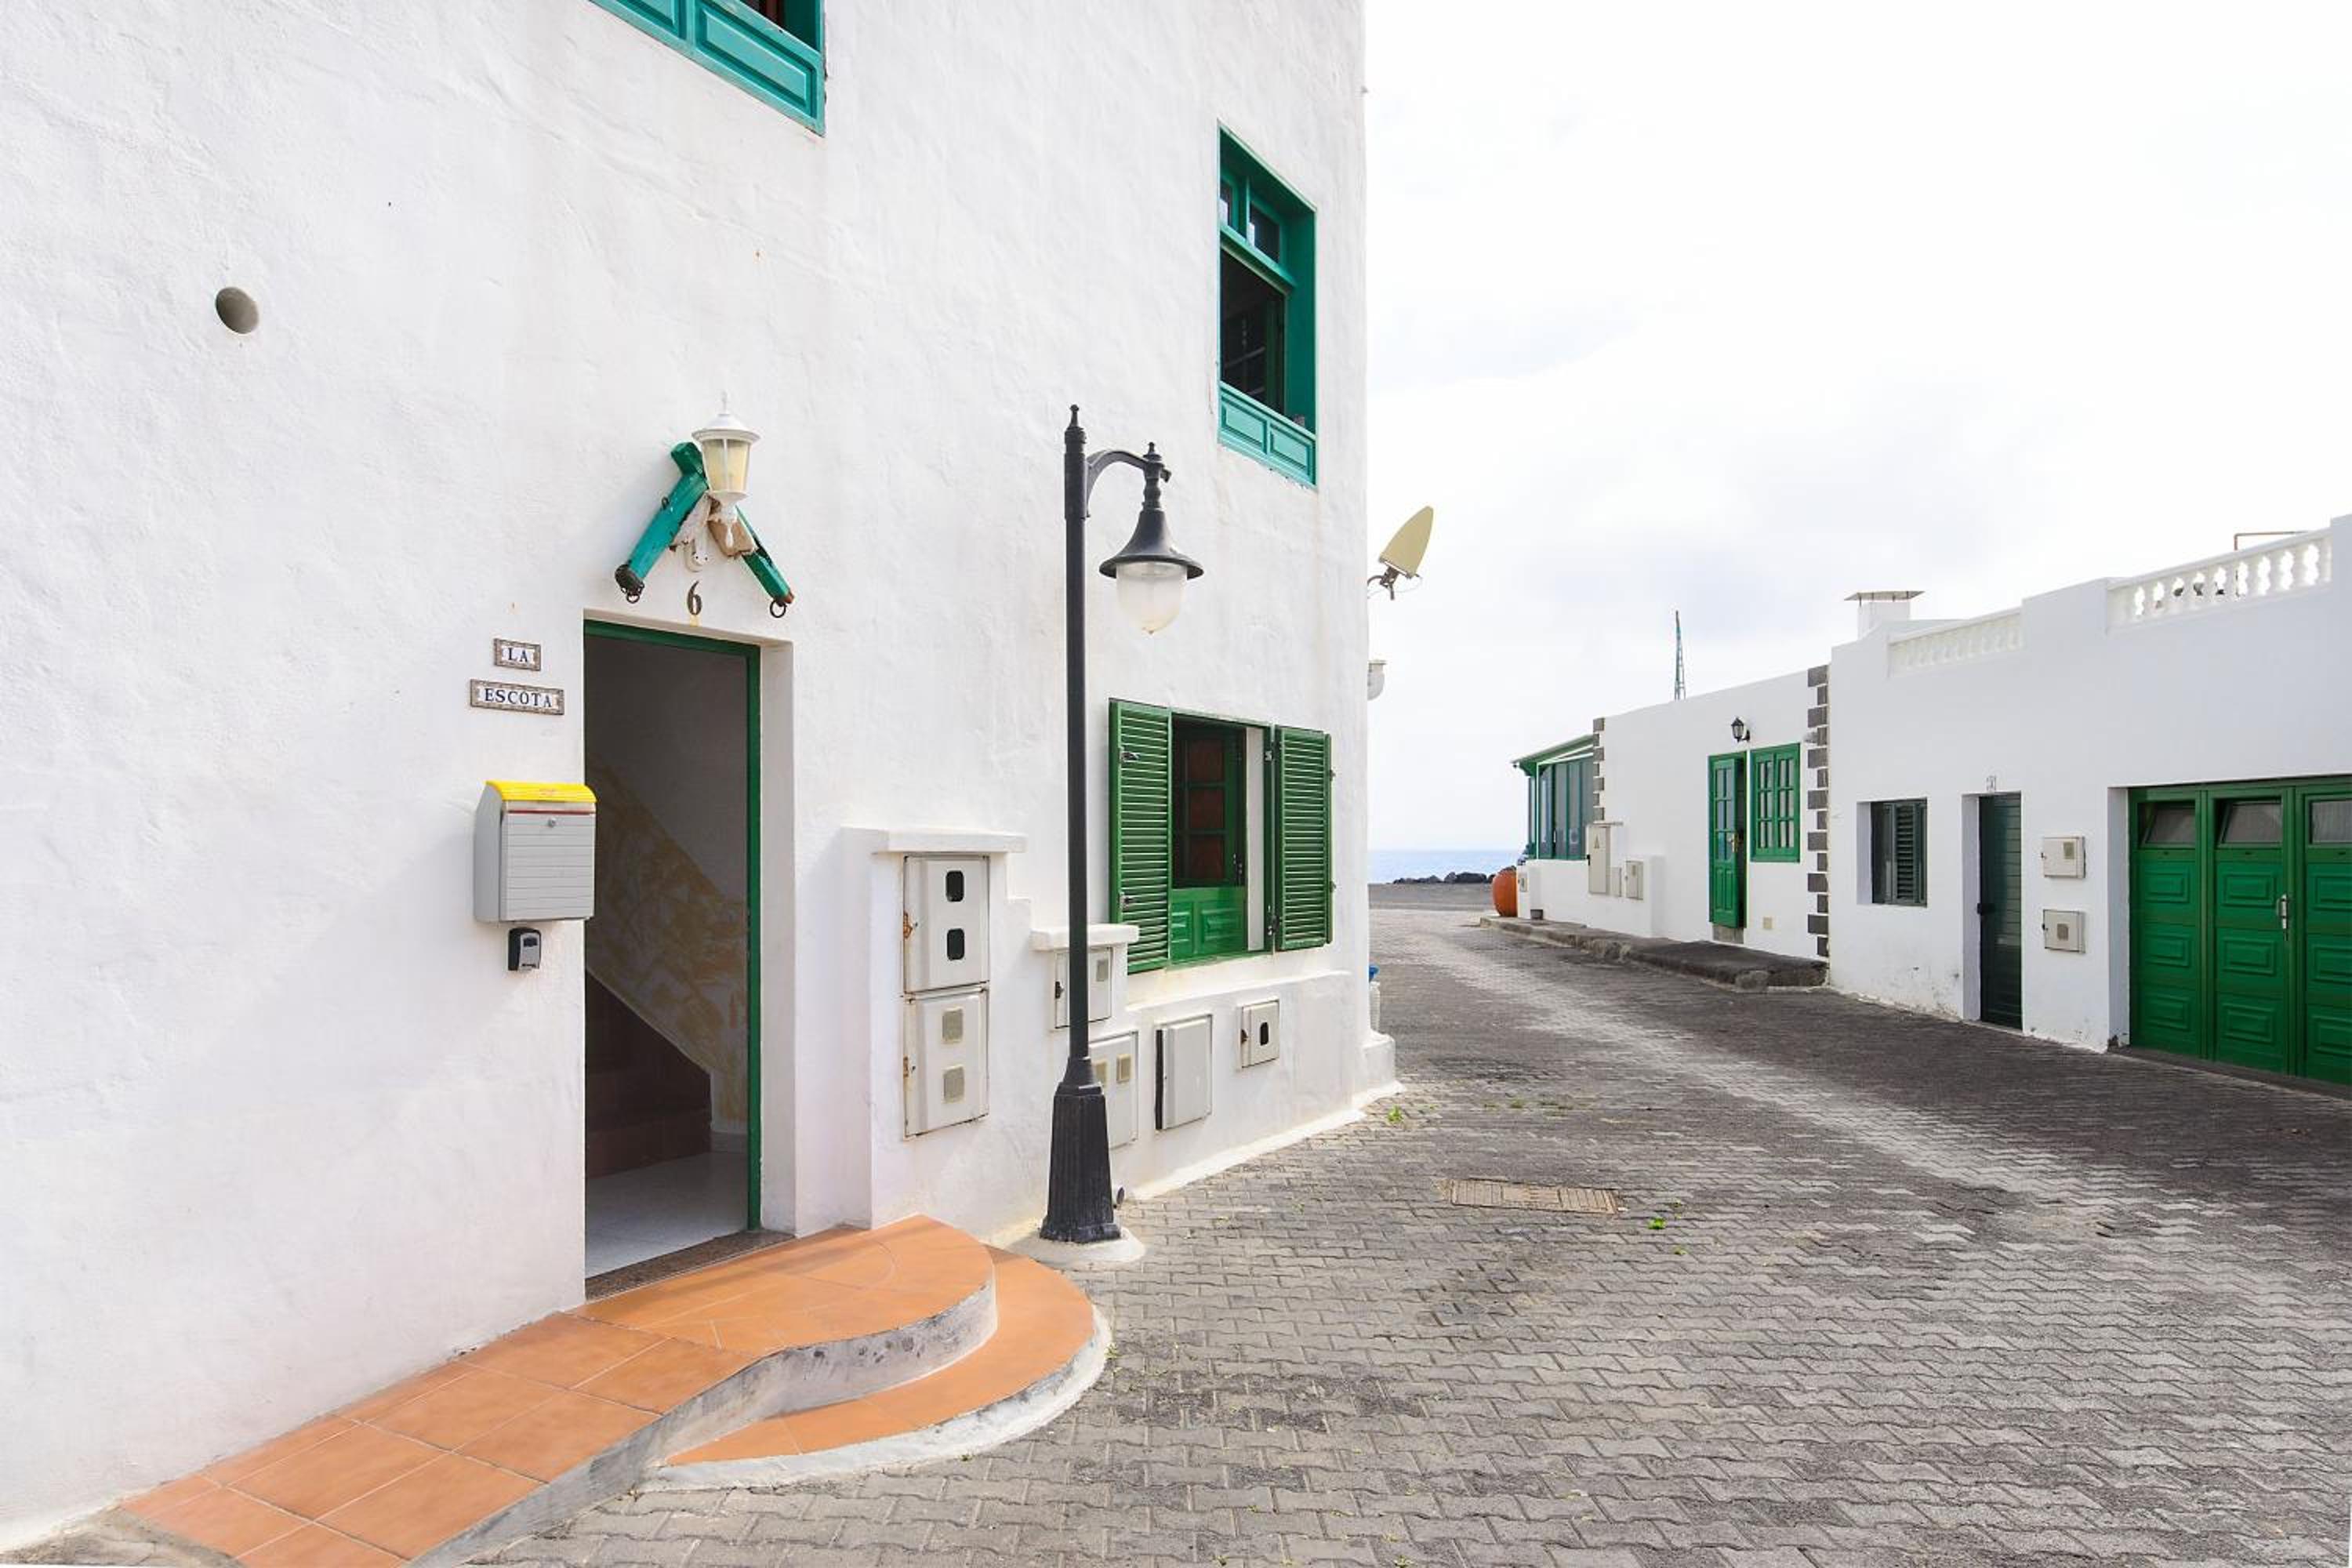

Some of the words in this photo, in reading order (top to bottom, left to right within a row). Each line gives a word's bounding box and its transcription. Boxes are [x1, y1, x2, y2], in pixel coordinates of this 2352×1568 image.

[687, 580, 702, 615] 6
[508, 648, 528, 662] LA
[485, 688, 552, 708] ESCOTA
